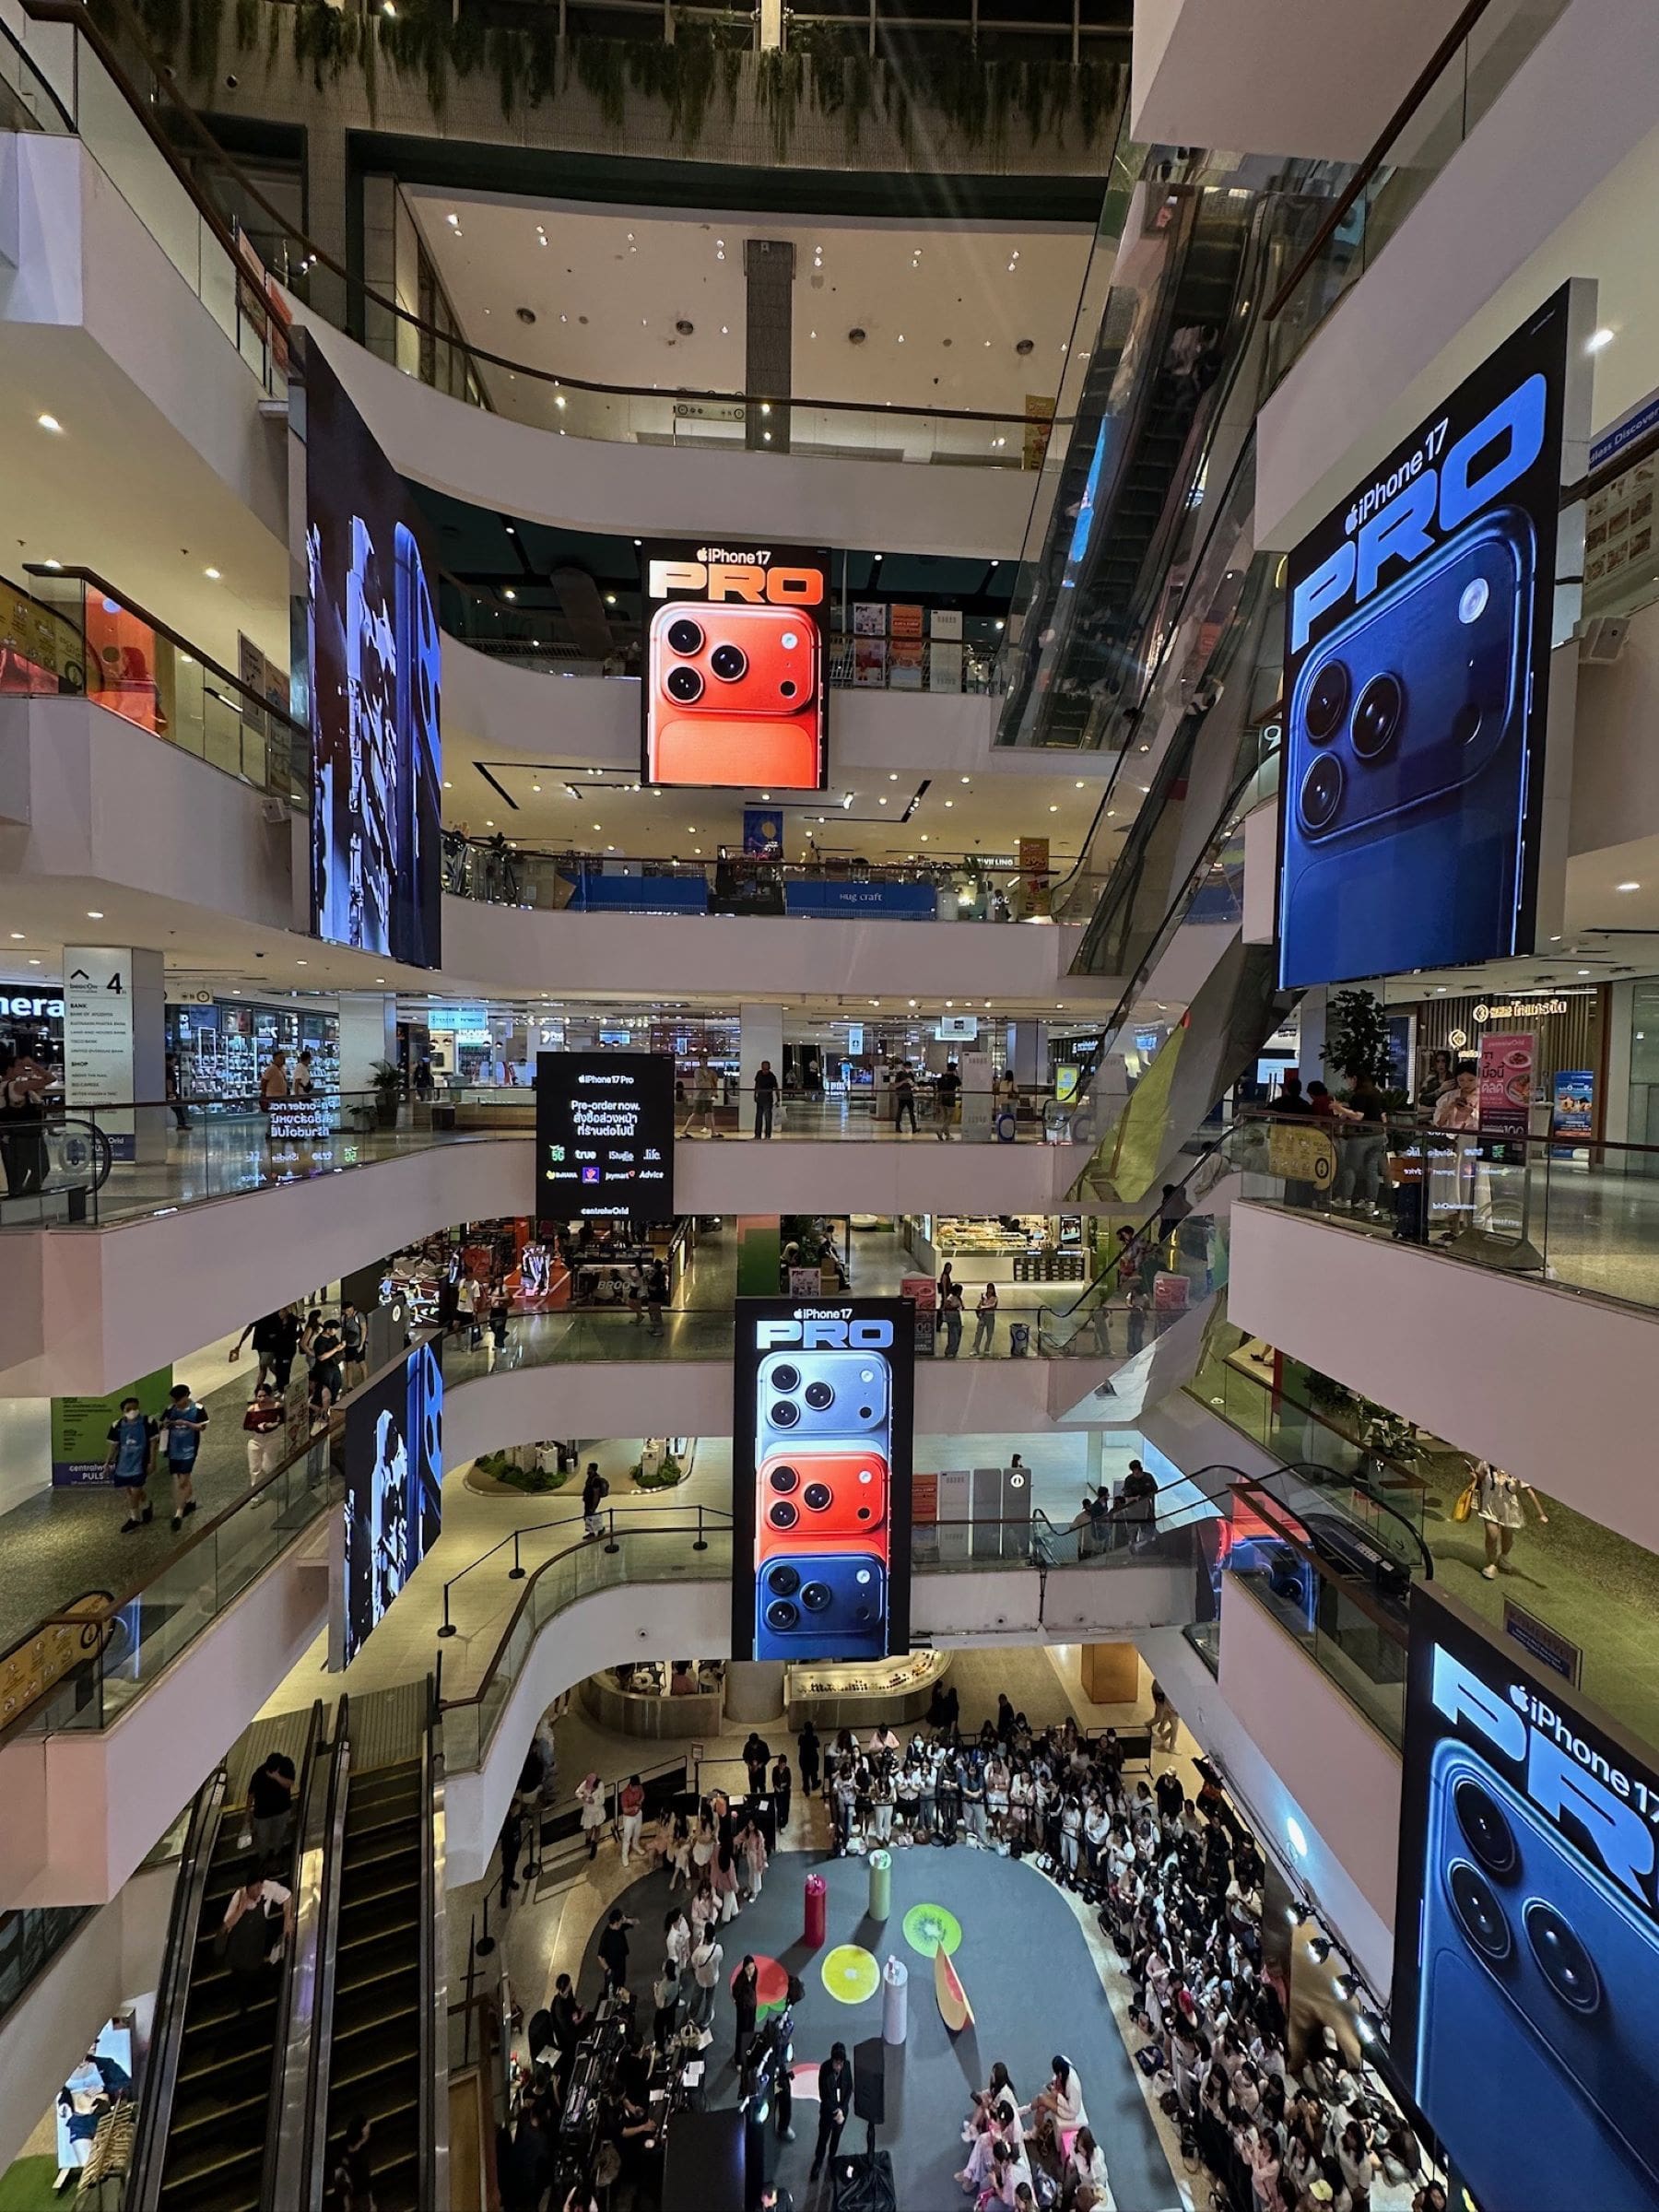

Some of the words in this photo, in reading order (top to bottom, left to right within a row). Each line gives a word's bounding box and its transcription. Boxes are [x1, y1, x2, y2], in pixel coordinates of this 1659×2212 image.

[1359, 451, 1422, 524] iPhone
[1425, 417, 1449, 461] 17
[1291, 372, 1547, 654] PRO
[709, 547, 755, 564] iPhone
[756, 550, 771, 565] 17
[649, 559, 823, 605] PRO
[106, 972, 123, 994] 4
[585, 1075, 611, 1084] iPhone
[611, 1075, 620, 1084] 17
[620, 1076, 634, 1084] Pro
[571, 1100, 616, 1111] Pre-order
[618, 1101, 641, 1111] now.
[552, 1151, 565, 1161] 5G
[574, 1150, 596, 1159] true
[639, 1170, 664, 1179] Advice
[803, 1308, 840, 1319] iPhone
[840, 1308, 853, 1319] 17
[756, 1320, 894, 1349] PRO
[1530, 1690, 1630, 1797] iPhone
[1432, 1641, 1659, 1910] PR
